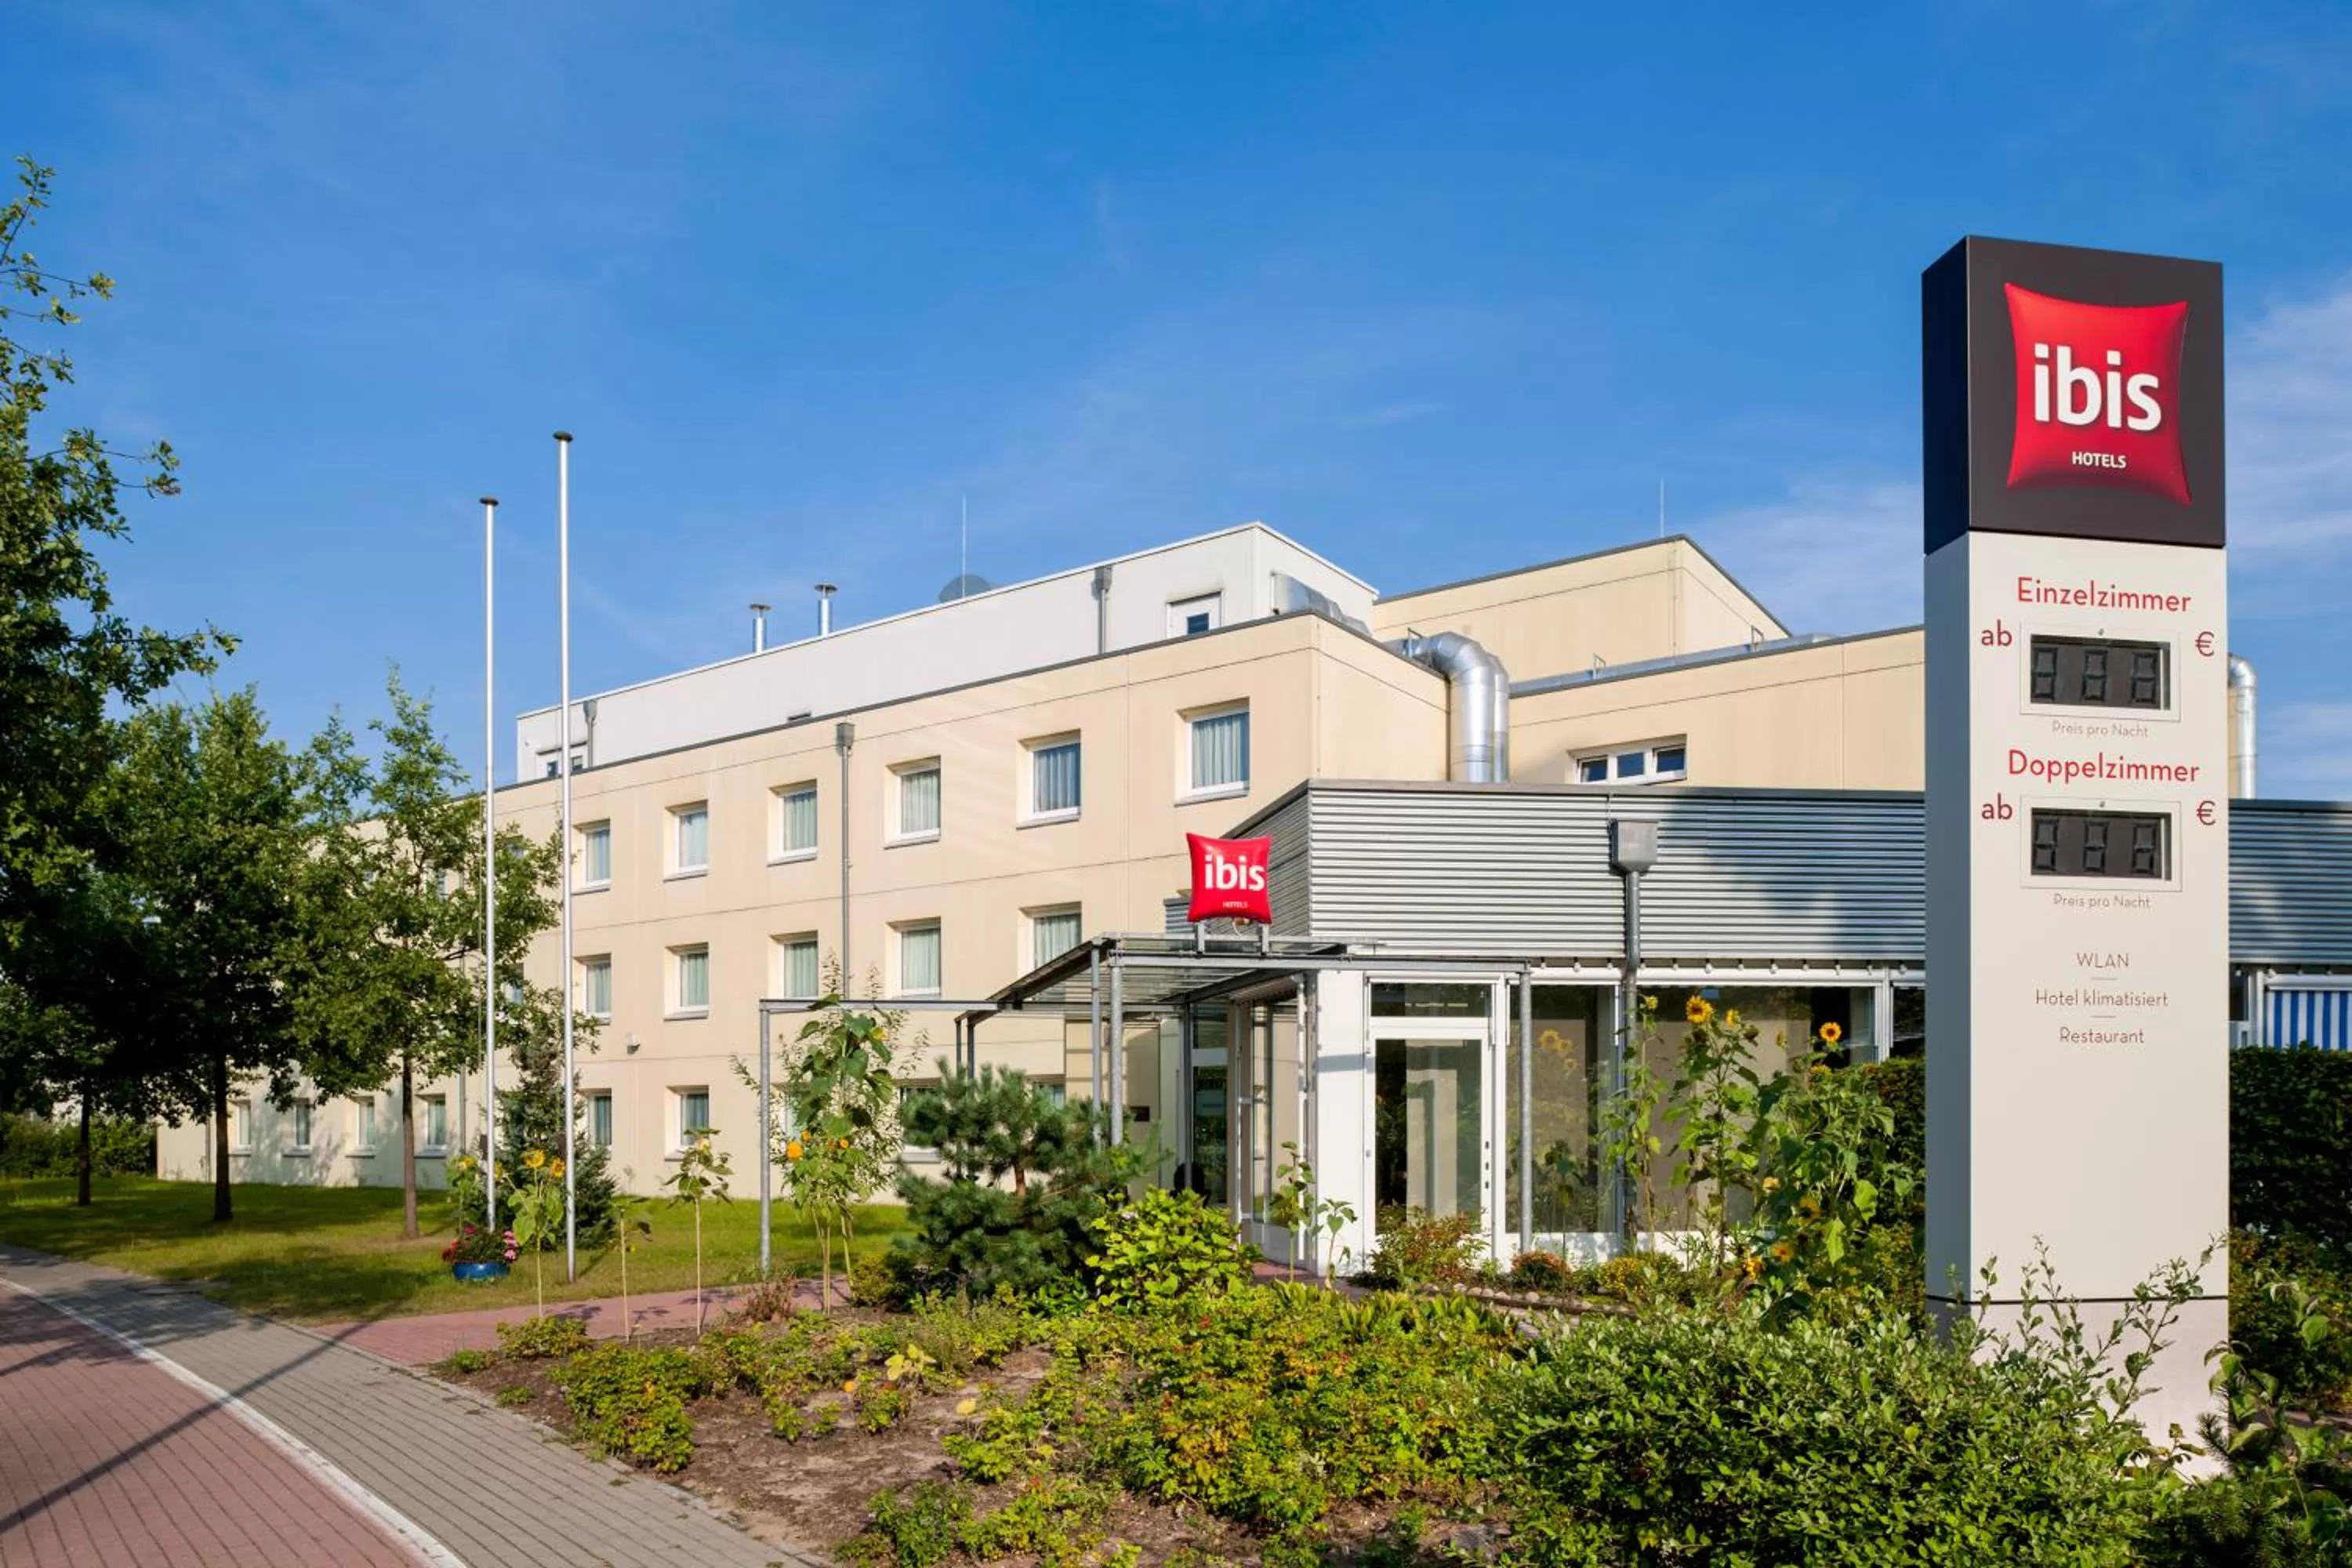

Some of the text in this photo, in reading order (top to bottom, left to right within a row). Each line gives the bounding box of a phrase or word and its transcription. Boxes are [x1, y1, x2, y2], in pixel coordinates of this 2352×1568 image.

[2034, 343, 2161, 432] ibis
[2072, 452, 2127, 468] HOTELS
[2017, 576, 2191, 612] Einzelzimmer
[1981, 619, 2013, 647] ab
[2195, 630, 2216, 657] €
[2052, 718, 2148, 738] Preis pro Nacht
[2009, 749, 2200, 784] Doppelzimmer
[1981, 792, 2013, 820] ab
[2197, 800, 2216, 826] €
[1205, 854, 1265, 891] ibis
[2053, 892, 2151, 910] Preis pro Nacht
[2076, 952, 2129, 969] WLAN
[2035, 988, 2169, 1007] Hotel klimatisiert
[2060, 1025, 2145, 1044] Restaurant
